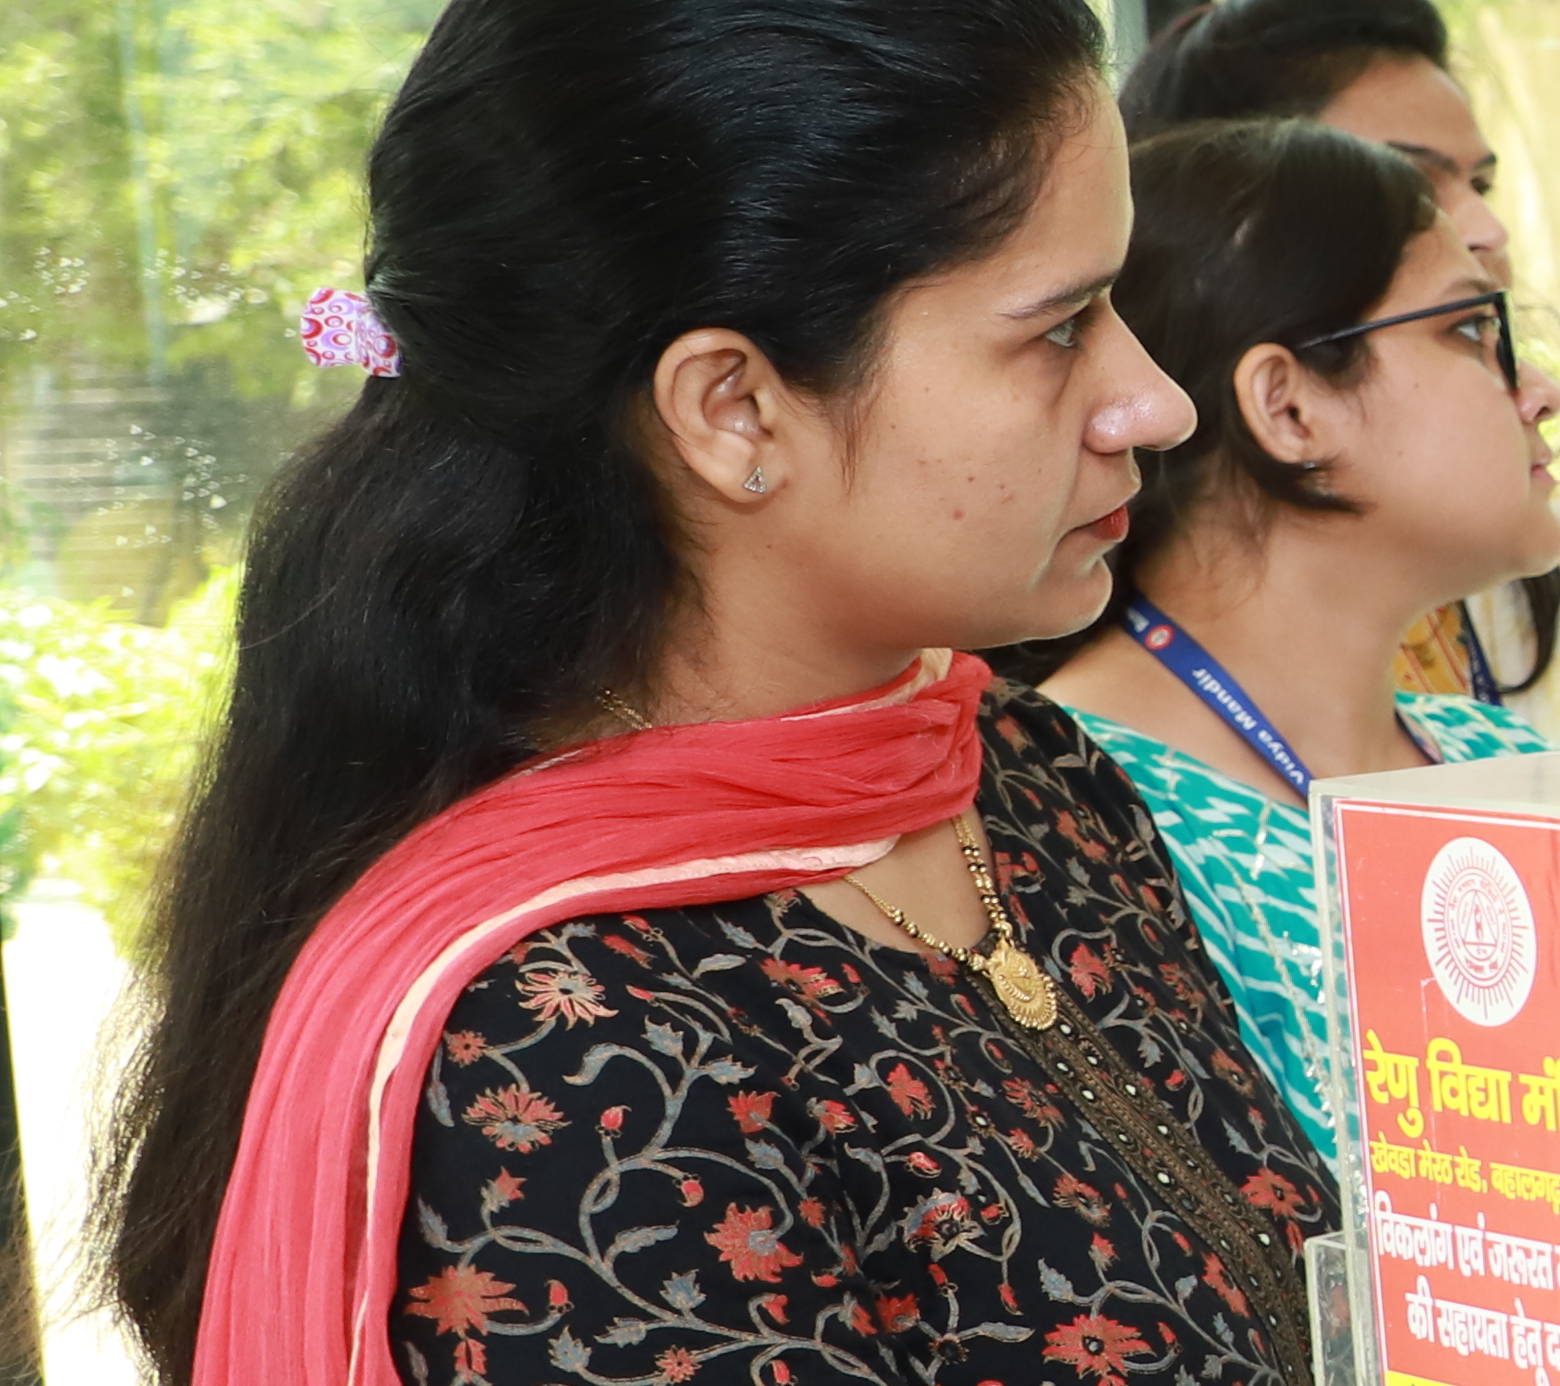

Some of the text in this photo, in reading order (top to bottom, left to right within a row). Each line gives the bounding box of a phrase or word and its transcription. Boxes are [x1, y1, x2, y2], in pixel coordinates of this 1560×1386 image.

[1192, 667, 1305, 785] Vidya Mandir
[1362, 1028, 1426, 1139] रेणु
[1425, 1036, 1513, 1124] विद्या
[1417, 1138, 1453, 1185] मेरठ
[1374, 1189, 1455, 1270] विकलांग
[1455, 1211, 1486, 1277] एवं
[1485, 1230, 1554, 1291] जरूरत
[1405, 1274, 1435, 1342] की
[1435, 1297, 1510, 1361] सहायता
